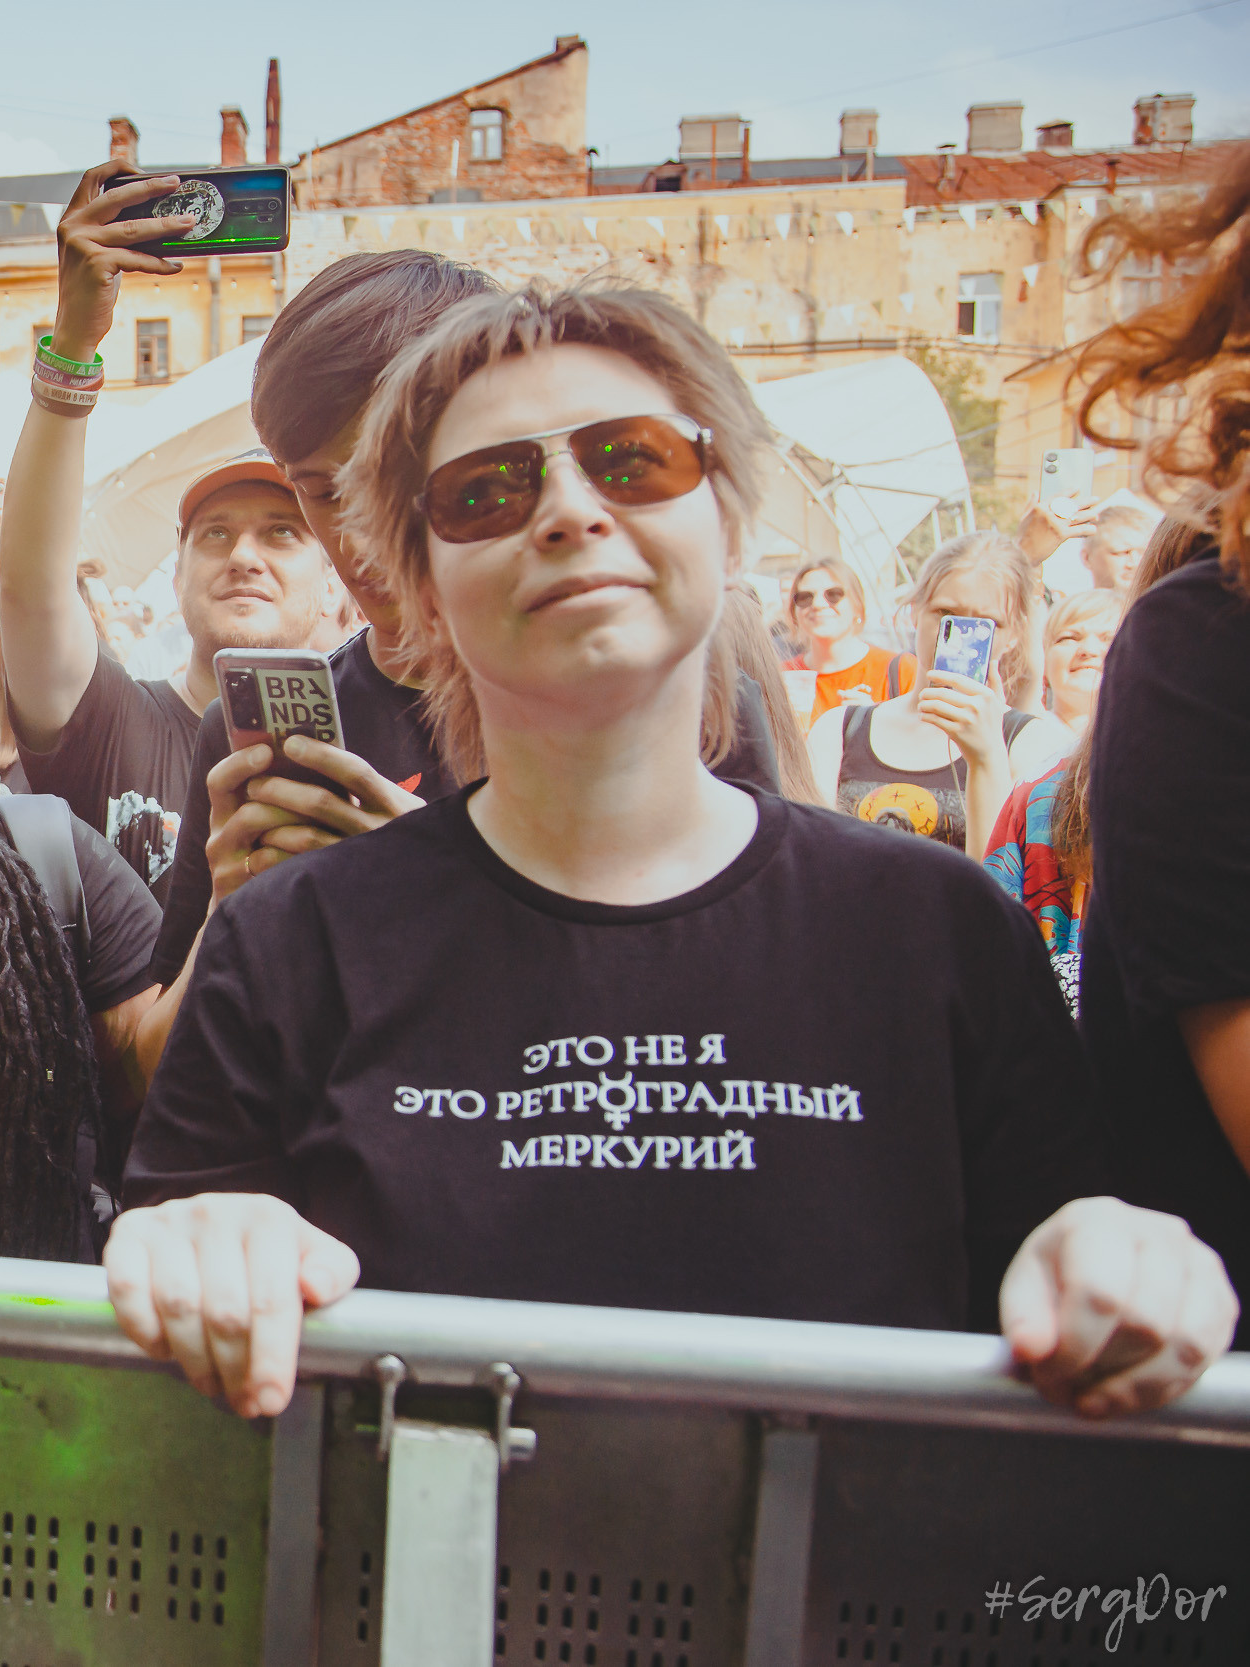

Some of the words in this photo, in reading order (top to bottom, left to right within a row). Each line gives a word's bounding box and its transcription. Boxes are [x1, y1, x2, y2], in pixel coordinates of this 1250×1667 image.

[270, 702, 333, 726] NDS
[523, 1035, 614, 1074] ЭТО
[624, 1034, 687, 1066] НЕ
[695, 1033, 726, 1065] Я
[393, 1085, 486, 1120] ЭТО
[499, 1129, 757, 1170] МЕРКУРИЙ
